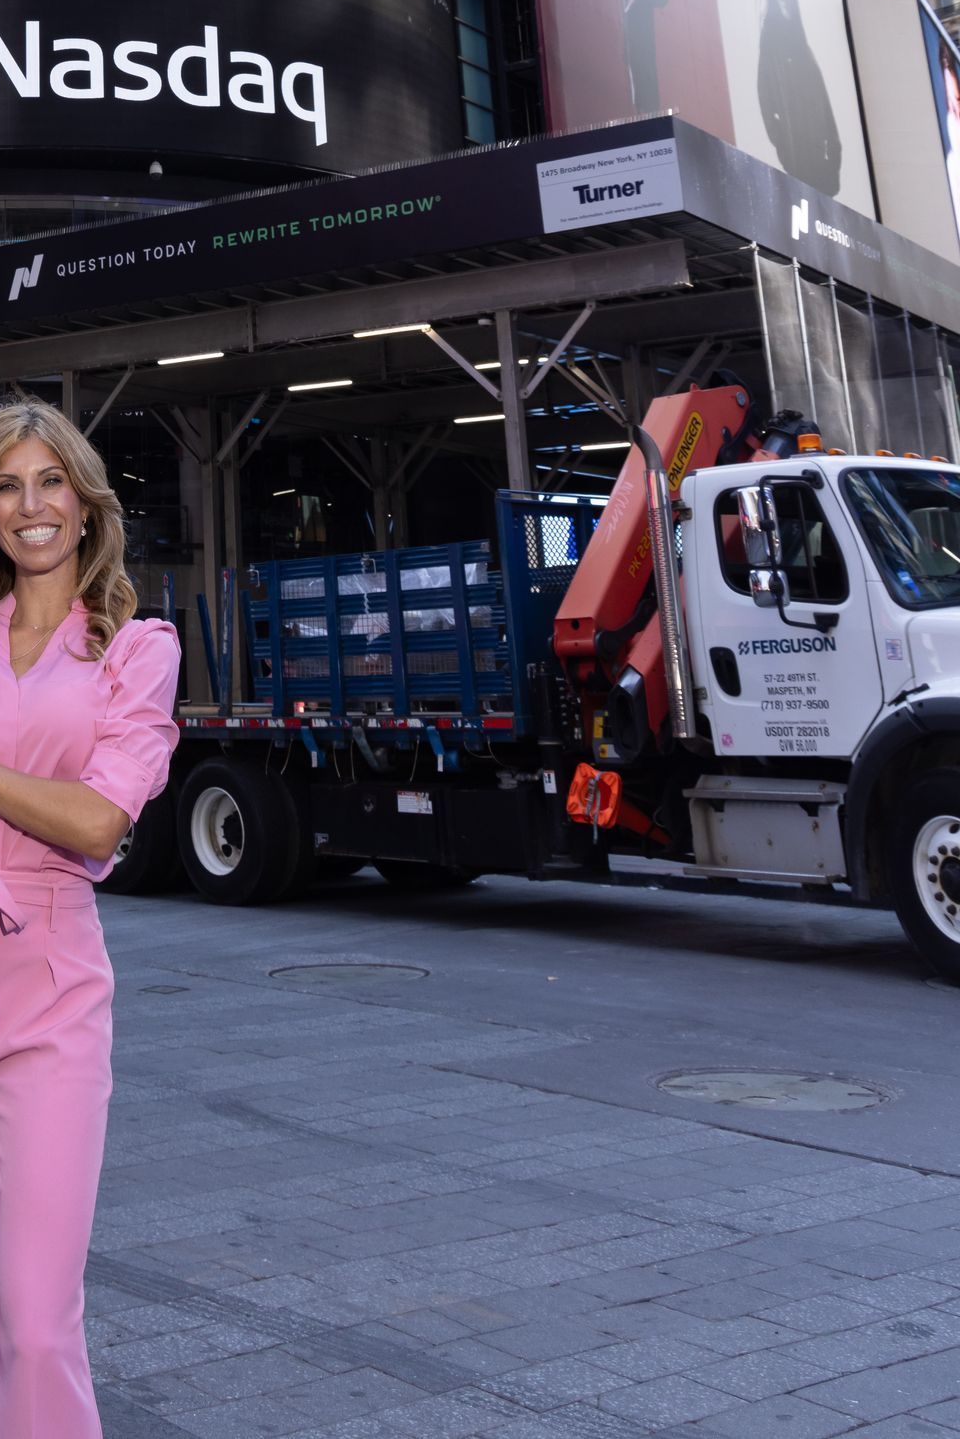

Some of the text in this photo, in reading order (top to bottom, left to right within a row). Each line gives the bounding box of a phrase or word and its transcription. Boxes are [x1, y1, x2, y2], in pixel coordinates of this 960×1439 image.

[540, 147, 673, 178] 1475 Broadway New York, NY 10036
[572, 180, 645, 205] Turner
[814, 220, 857, 250] QUESTION
[56, 251, 137, 278] QUESTION
[143, 240, 198, 262] TODAY
[212, 221, 302, 250] REWRITE
[667, 416, 702, 488] PALFINGER
[751, 637, 837, 655] FERGUSON
[763, 673, 820, 683] 57-22 49TH ST.
[767, 686, 817, 696] MASPETH, NY
[761, 699, 830, 711] (718) 937-9500
[764, 726, 794, 737] USDOT
